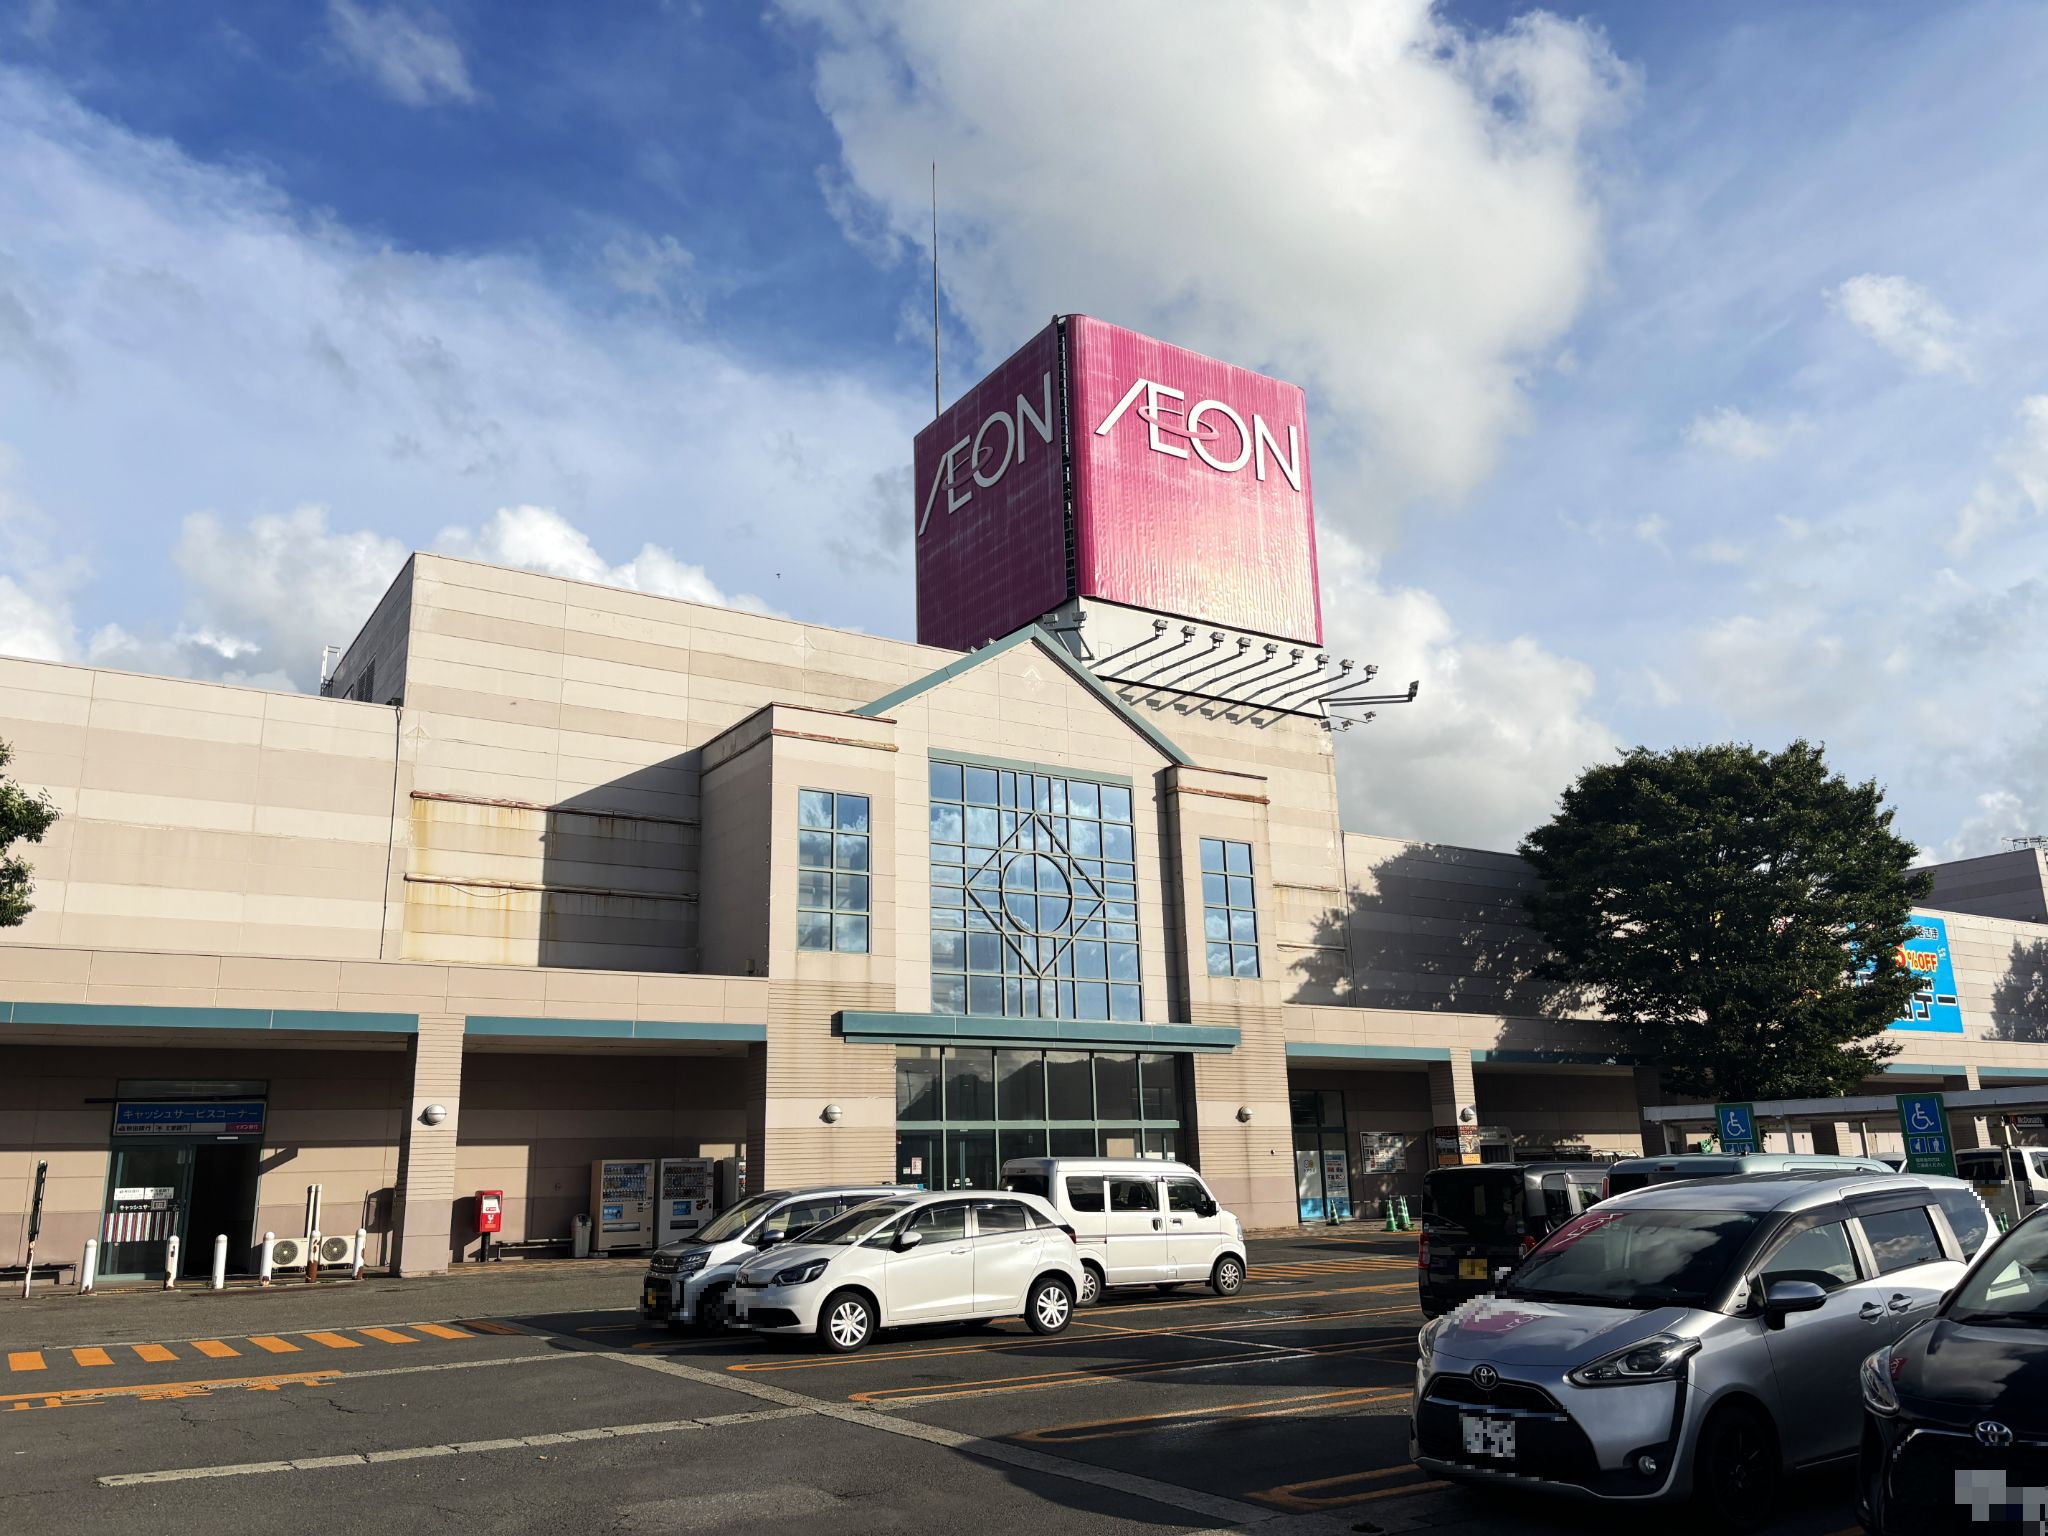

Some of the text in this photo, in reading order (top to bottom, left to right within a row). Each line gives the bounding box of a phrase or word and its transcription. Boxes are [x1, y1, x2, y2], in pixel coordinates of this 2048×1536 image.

[123, 1108, 258, 1120] キャッシュサービスコーナー
